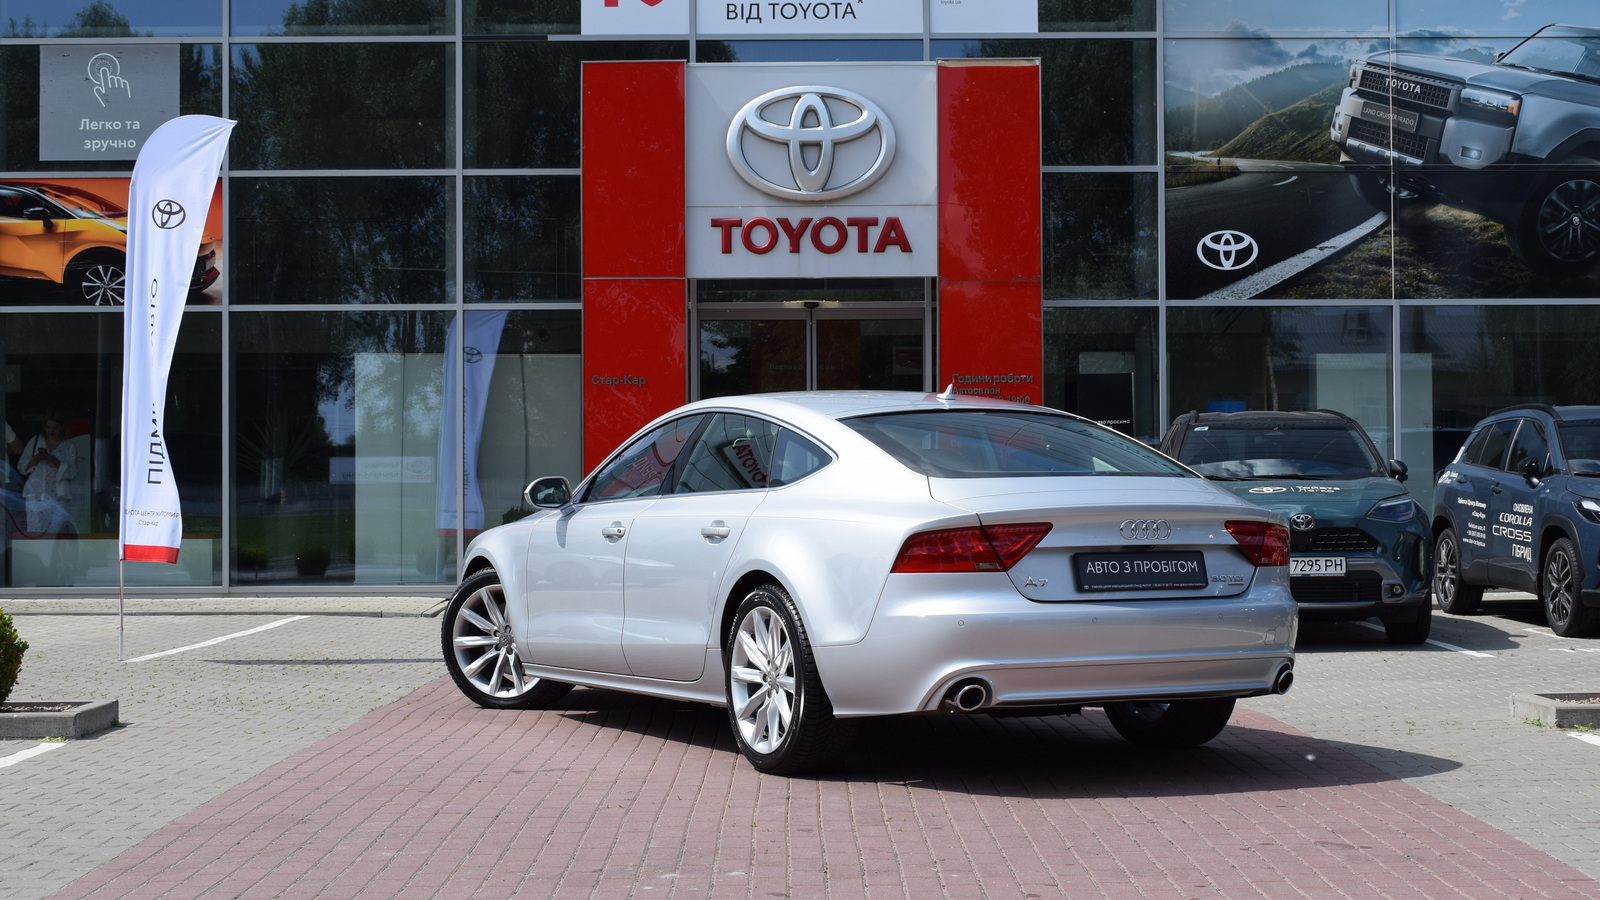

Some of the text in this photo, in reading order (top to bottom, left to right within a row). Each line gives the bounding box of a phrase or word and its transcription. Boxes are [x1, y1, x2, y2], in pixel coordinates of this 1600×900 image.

[726, 4, 762, 24] ВІД
[1385, 77, 1421, 94] TOYOTA
[1363, 107, 1376, 116] LAND
[1398, 114, 1414, 126] PRADO
[79, 118, 140, 130] Легко та
[83, 139, 137, 152] зручно
[711, 217, 913, 254] TOYOTA
[591, 375, 647, 387] Стар-Кар
[952, 373, 1034, 385] Години роботи
[952, 386, 1001, 395] Автосалон
[1513, 502, 1534, 514] ОНОВЛЕНА
[1499, 512, 1533, 526] COROLLA
[1492, 525, 1532, 542] CROSS
[1512, 544, 1532, 563] ГІБРИД
[1086, 560, 1198, 573] АВТО З ПРОБІГОМ
[1292, 559, 1343, 572] 7295 PH
[1024, 575, 1049, 588] A7
